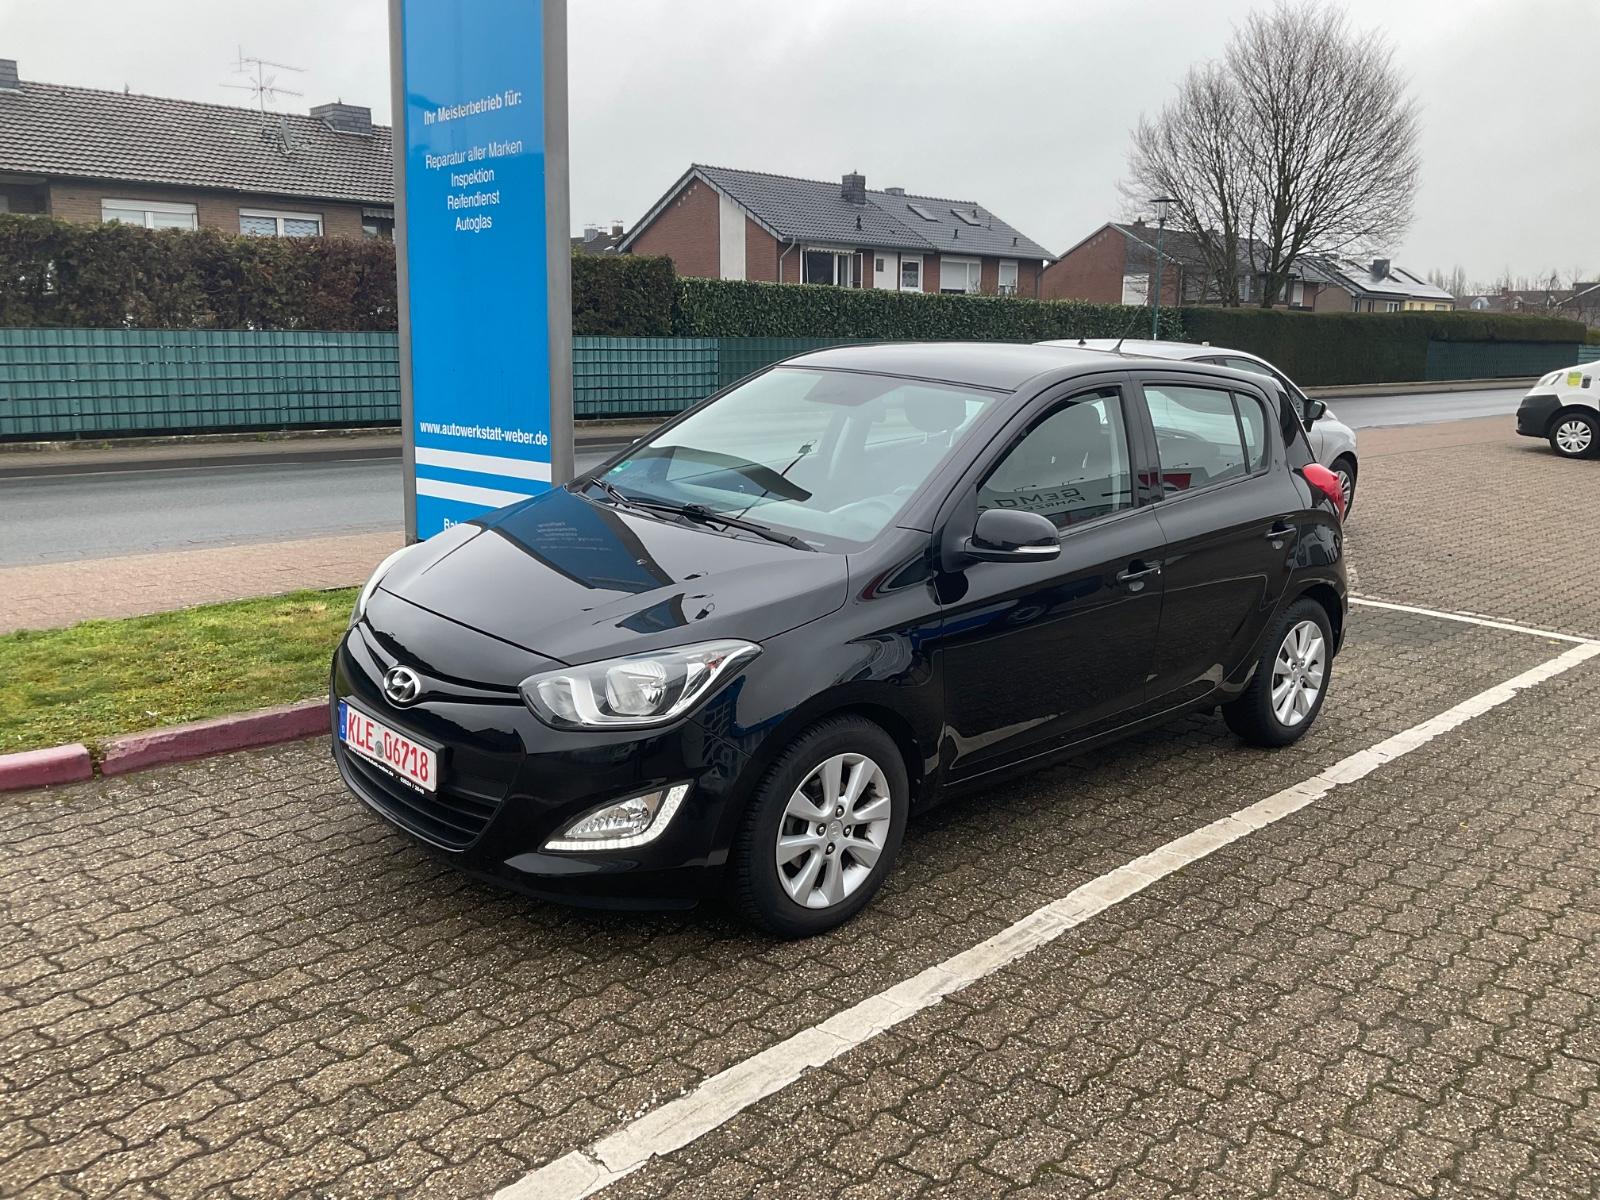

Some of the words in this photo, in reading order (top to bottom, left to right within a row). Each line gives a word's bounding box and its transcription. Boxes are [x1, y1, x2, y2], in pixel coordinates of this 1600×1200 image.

[424, 110, 436, 125] Ihr
[437, 94, 502, 122] Meisterbetrieb
[504, 90, 522, 107] für:
[426, 151, 465, 171] Reparatur
[467, 146, 486, 162] aller
[489, 141, 522, 157] Marken
[451, 168, 495, 188] Inspektion
[447, 189, 500, 210] Reifendienst
[456, 214, 492, 233] Autoglas
[420, 422, 548, 446] www.autowerkstatt-weber.de
[348, 712, 374, 751] KLE
[384, 732, 428, 781] 06718
